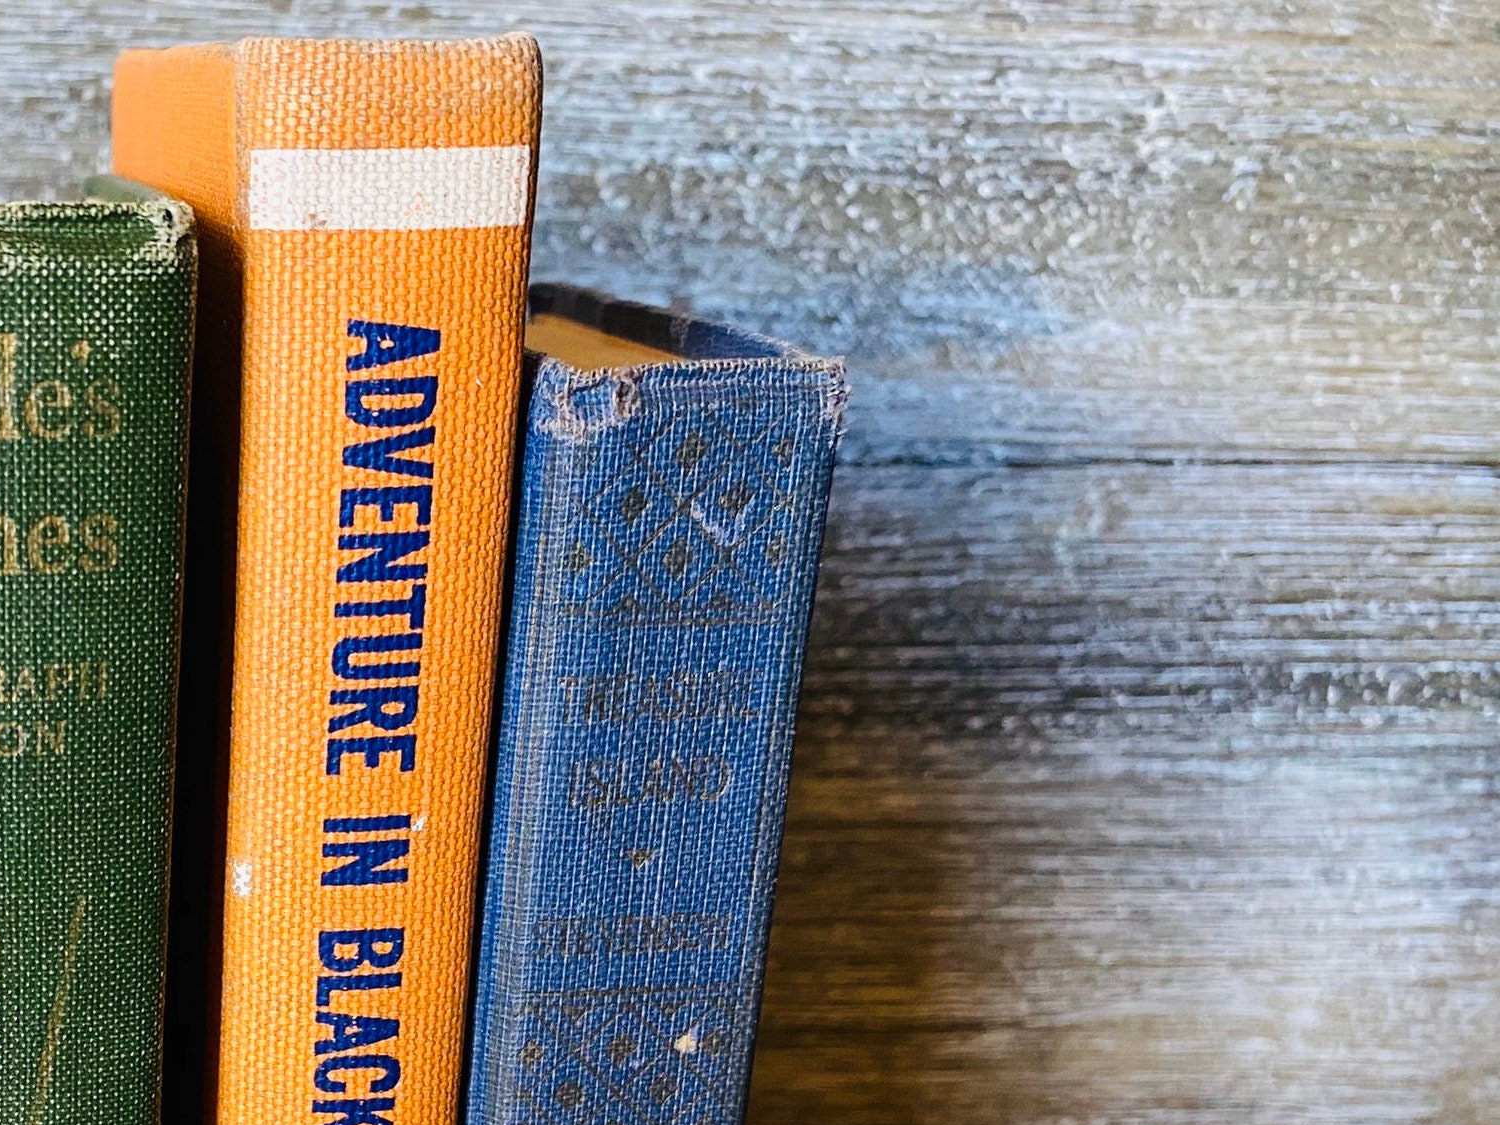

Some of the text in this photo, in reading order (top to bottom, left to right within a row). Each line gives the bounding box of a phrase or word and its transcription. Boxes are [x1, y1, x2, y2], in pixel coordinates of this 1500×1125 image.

[324, 318, 442, 777] ADVENTURE
[567, 753, 735, 807] ISLAND
[320, 813, 413, 887] IN
